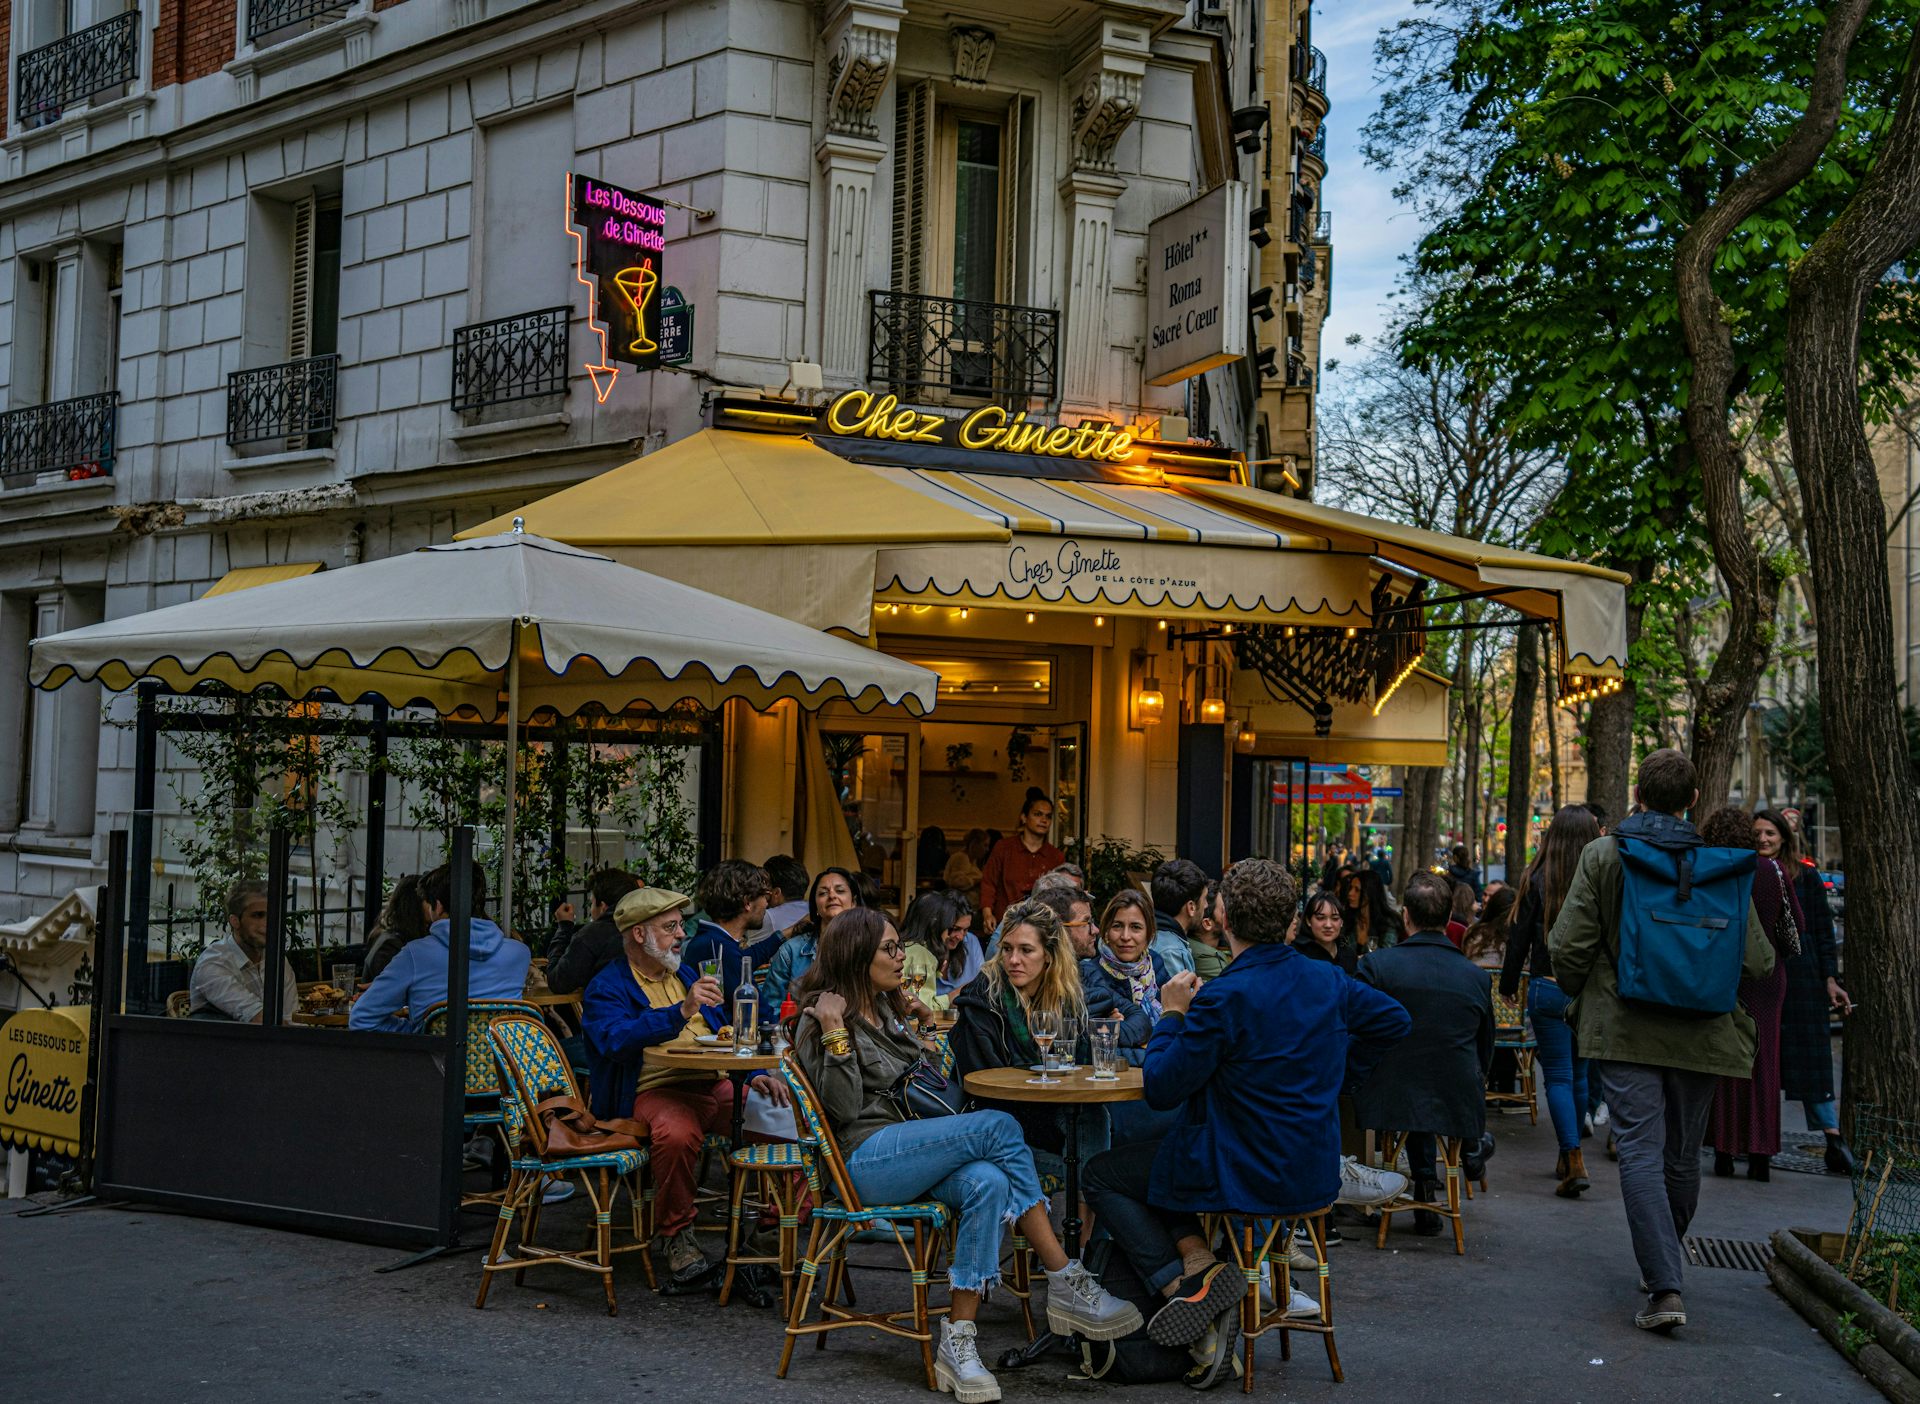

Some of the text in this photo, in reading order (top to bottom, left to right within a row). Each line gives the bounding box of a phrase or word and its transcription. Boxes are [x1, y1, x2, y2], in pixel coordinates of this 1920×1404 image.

[586, 181, 666, 225] Les Dessous
[605, 216, 665, 252] de Ginette
[1164, 234, 1194, 271] Hôtel
[1169, 277, 1202, 308] Roma
[660, 325, 682, 339] ERRE
[661, 315, 674, 328] UE
[1152, 305, 1218, 349] Sacré Cœur
[827, 389, 1135, 463] Chez Ginette
[1009, 540, 1121, 584] Chez Ginette
[1130, 576, 1155, 585] CÔTE
[9, 1027, 81, 1054] LES DESSOUS DE
[4, 1052, 78, 1115] Ginette
